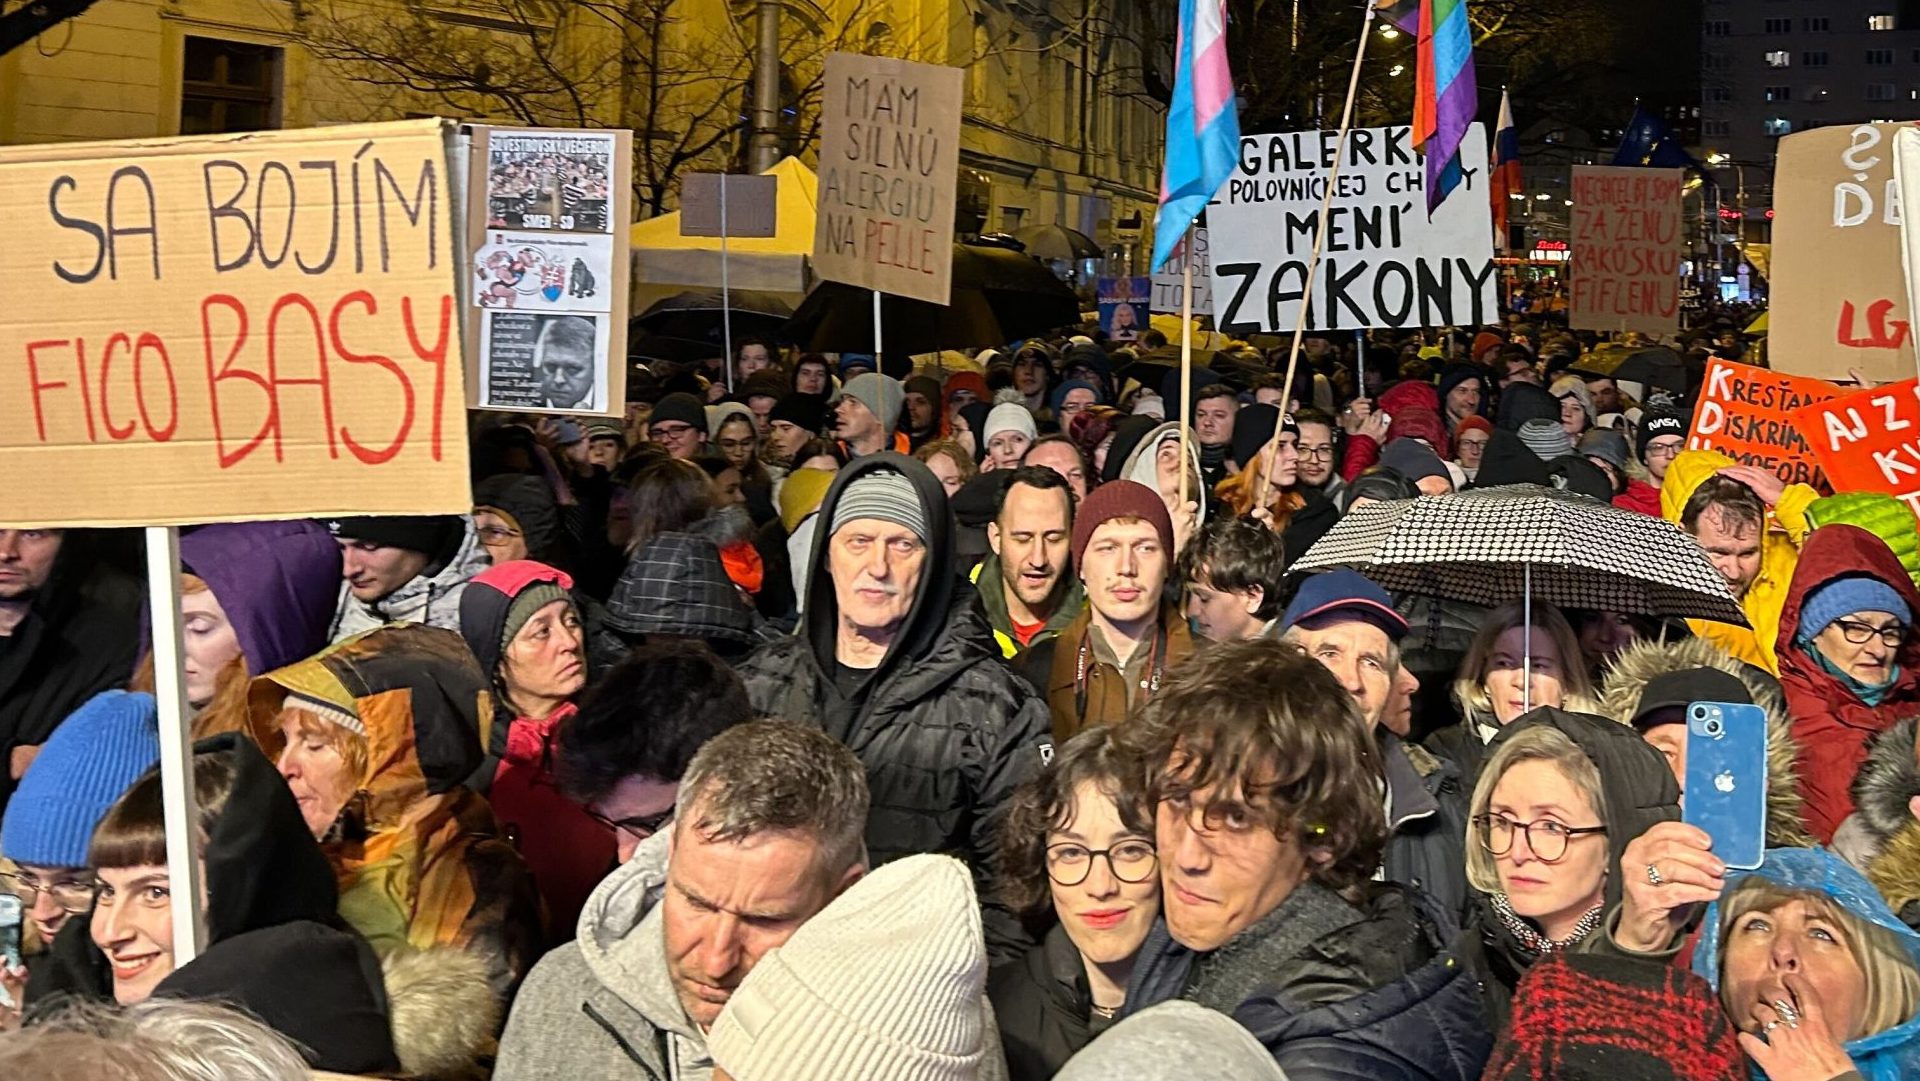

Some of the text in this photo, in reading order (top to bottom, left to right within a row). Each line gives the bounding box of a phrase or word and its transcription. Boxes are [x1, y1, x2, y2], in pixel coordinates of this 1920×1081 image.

[844, 122, 938, 177] SILNÚ
[1238, 126, 1425, 176] GALERK
[823, 167, 935, 223] ALERGIU
[1386, 167, 1478, 194] CHY
[1651, 176, 1681, 207] SOM
[49, 140, 438, 284] SA BOJÍM
[522, 213, 552, 229] SMER
[559, 215, 575, 230] SD
[1286, 202, 1413, 254] MENÍ
[1576, 206, 1677, 245] ZA ŽENU
[825, 212, 936, 275] NA PELLE
[1215, 257, 1496, 333] ZÁKONY
[26, 331, 178, 443] FICO
[201, 289, 452, 470] BASY
[1648, 417, 1682, 431] NASA
[1822, 395, 1912, 452] AJ Z
